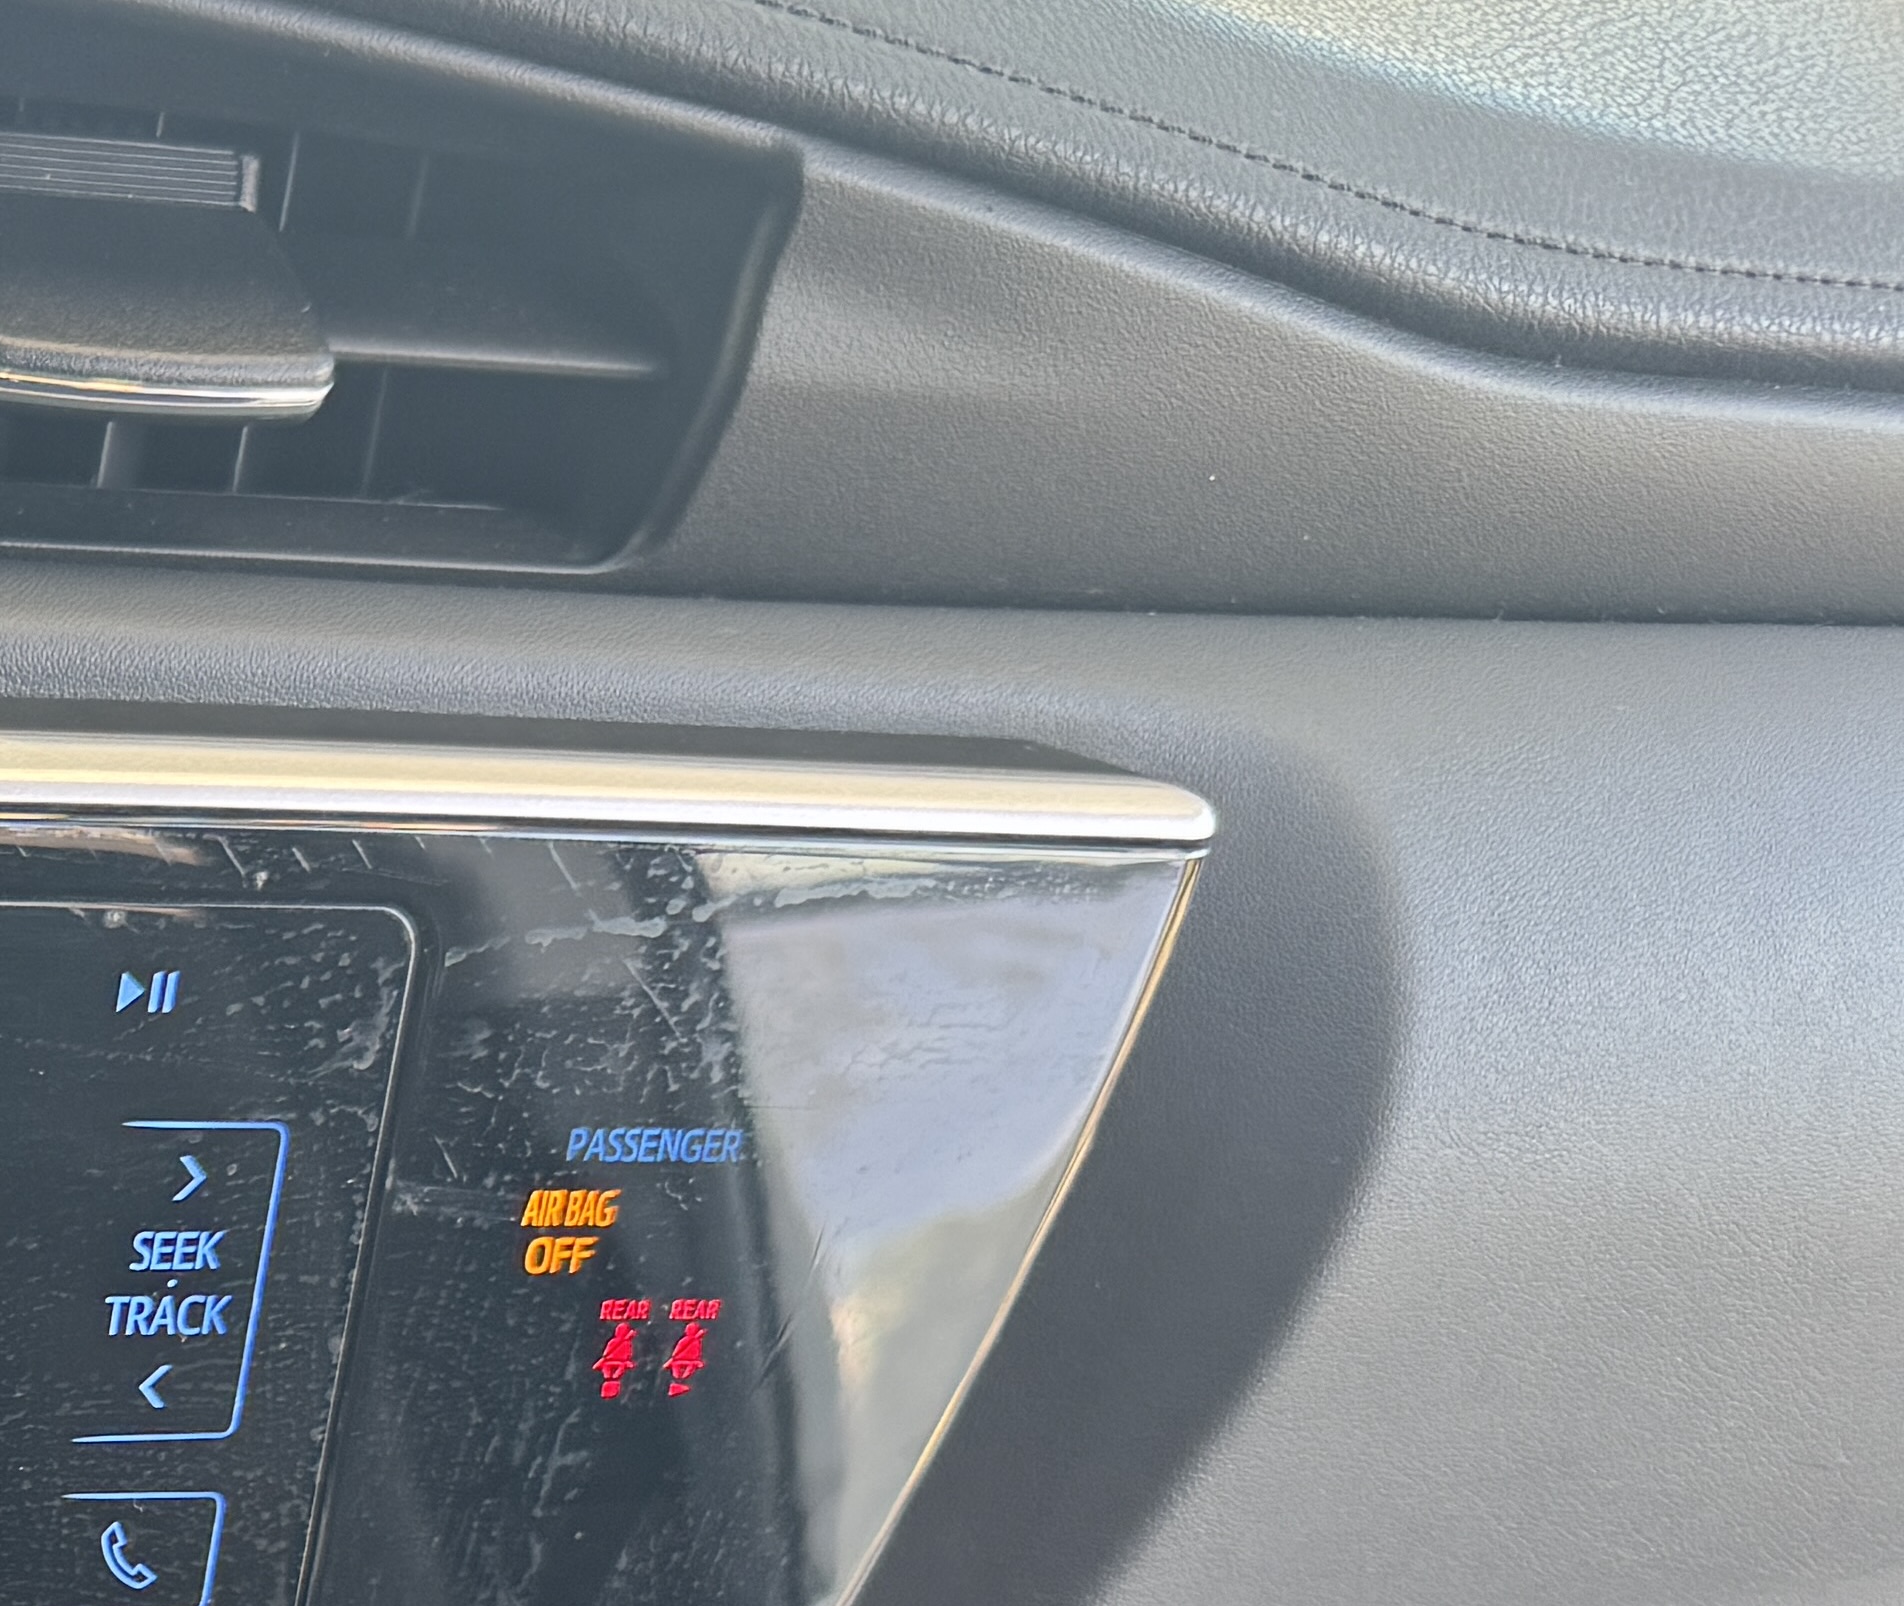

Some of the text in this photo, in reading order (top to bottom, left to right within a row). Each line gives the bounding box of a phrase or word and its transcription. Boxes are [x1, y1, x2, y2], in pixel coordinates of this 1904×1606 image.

[565, 1126, 745, 1164] PASSENGER
[128, 1230, 226, 1271] SEEK
[523, 1235, 601, 1275] OFF
[104, 1294, 233, 1337] TRACK
[599, 1298, 652, 1321] REAR
[668, 1298, 722, 1321] REAR
